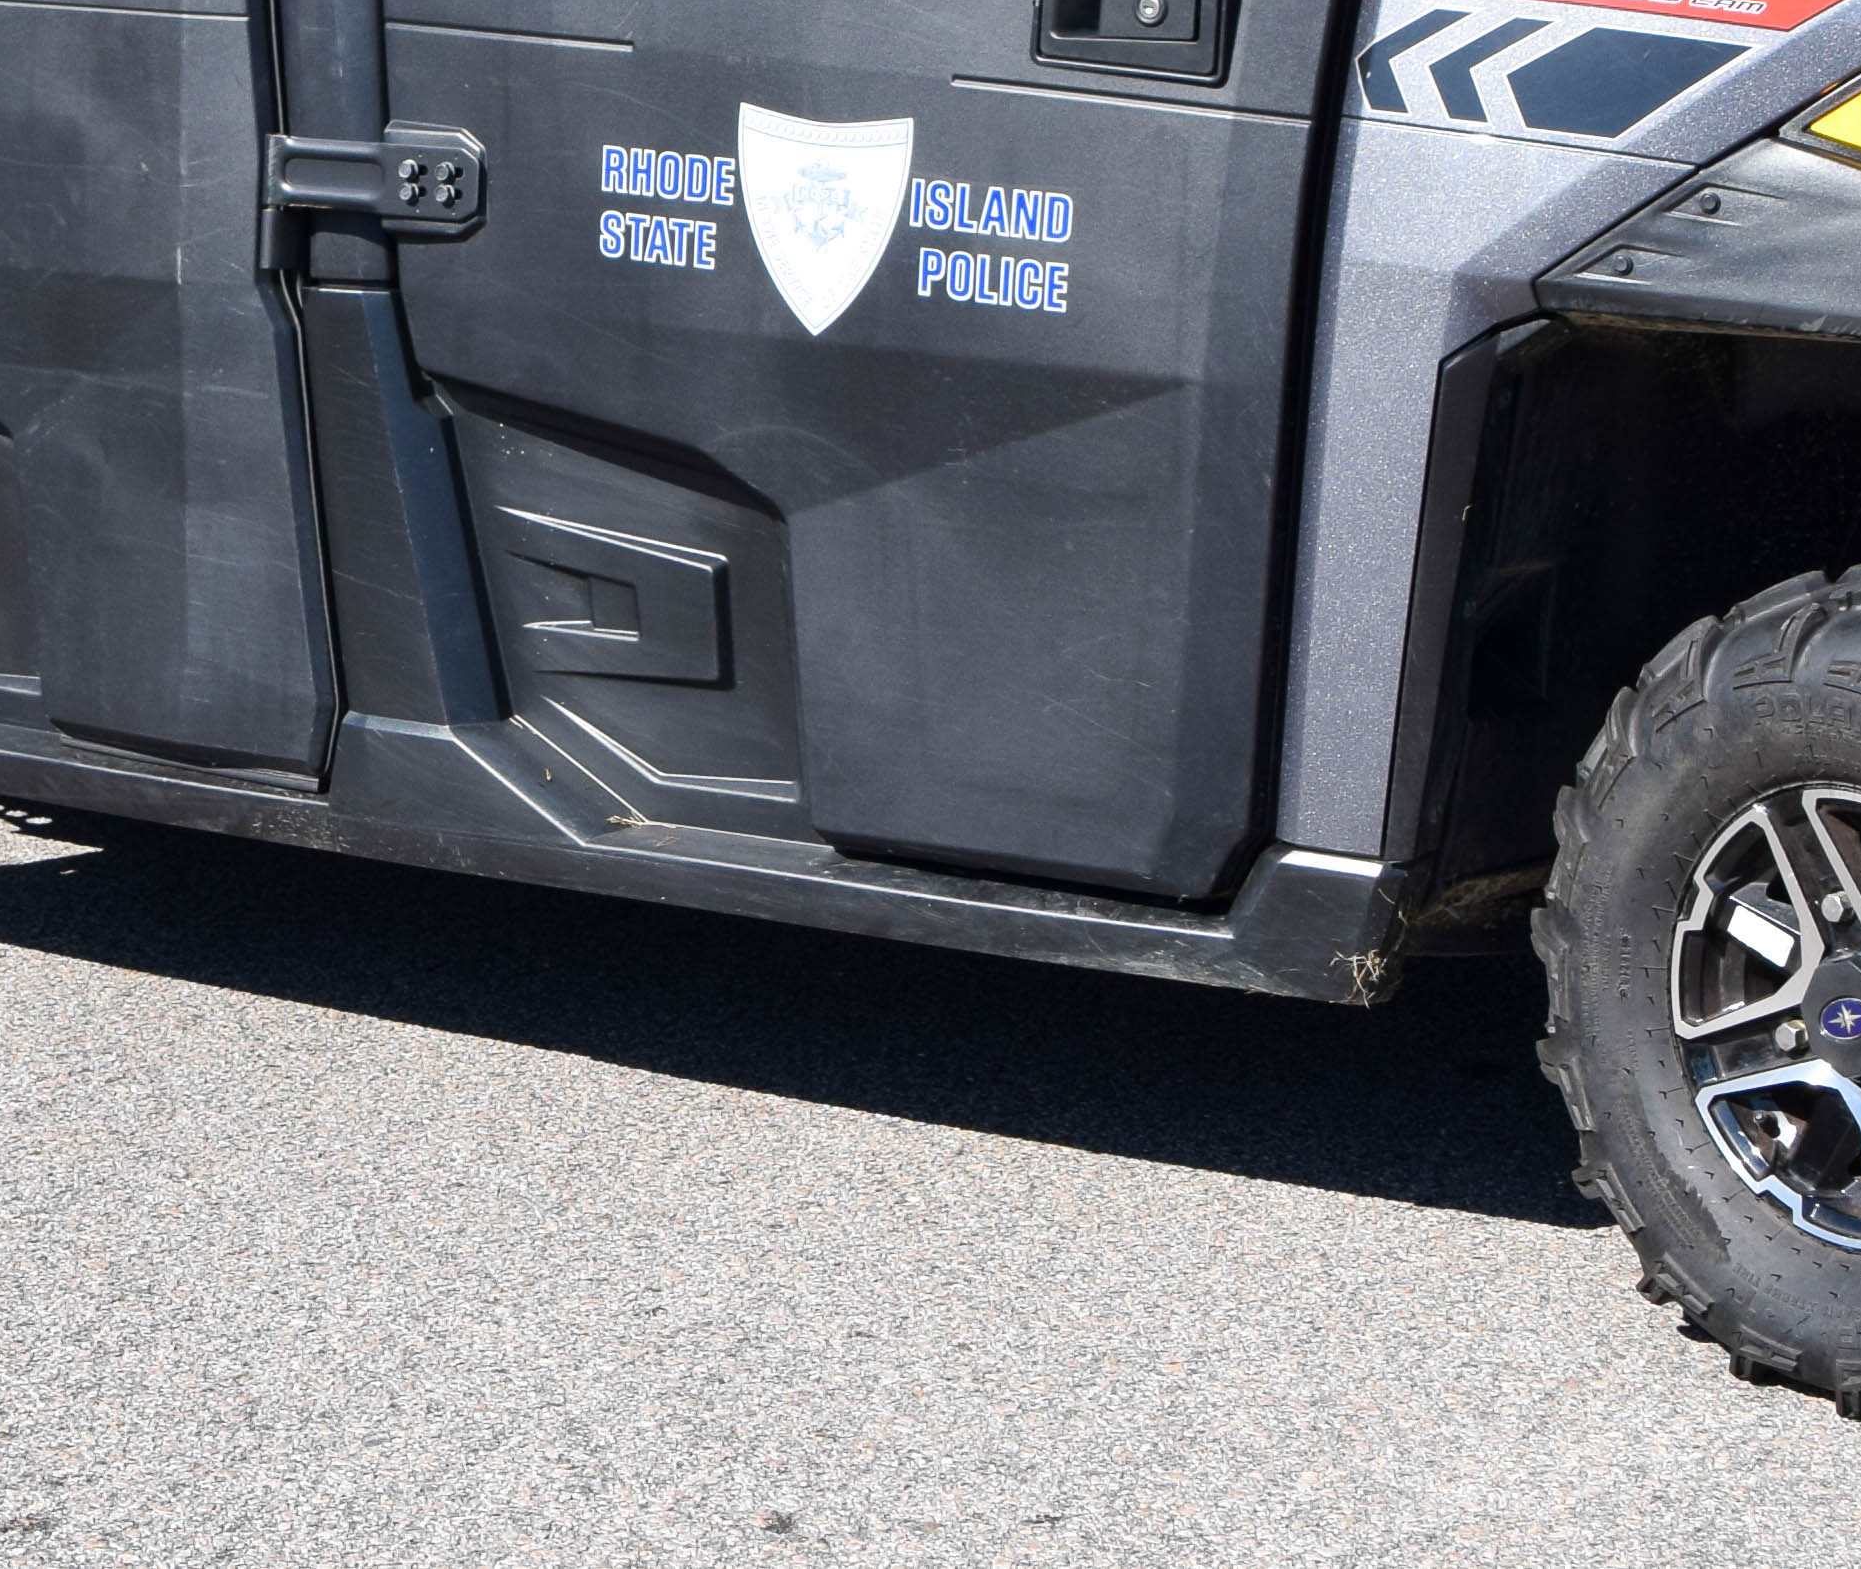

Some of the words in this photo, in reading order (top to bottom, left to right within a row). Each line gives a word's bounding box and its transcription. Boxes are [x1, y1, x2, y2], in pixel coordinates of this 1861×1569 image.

[601, 144, 736, 206] RHODE
[909, 177, 1074, 243] ISLAND
[599, 209, 717, 270] STATE
[917, 247, 1070, 313] POLICE
